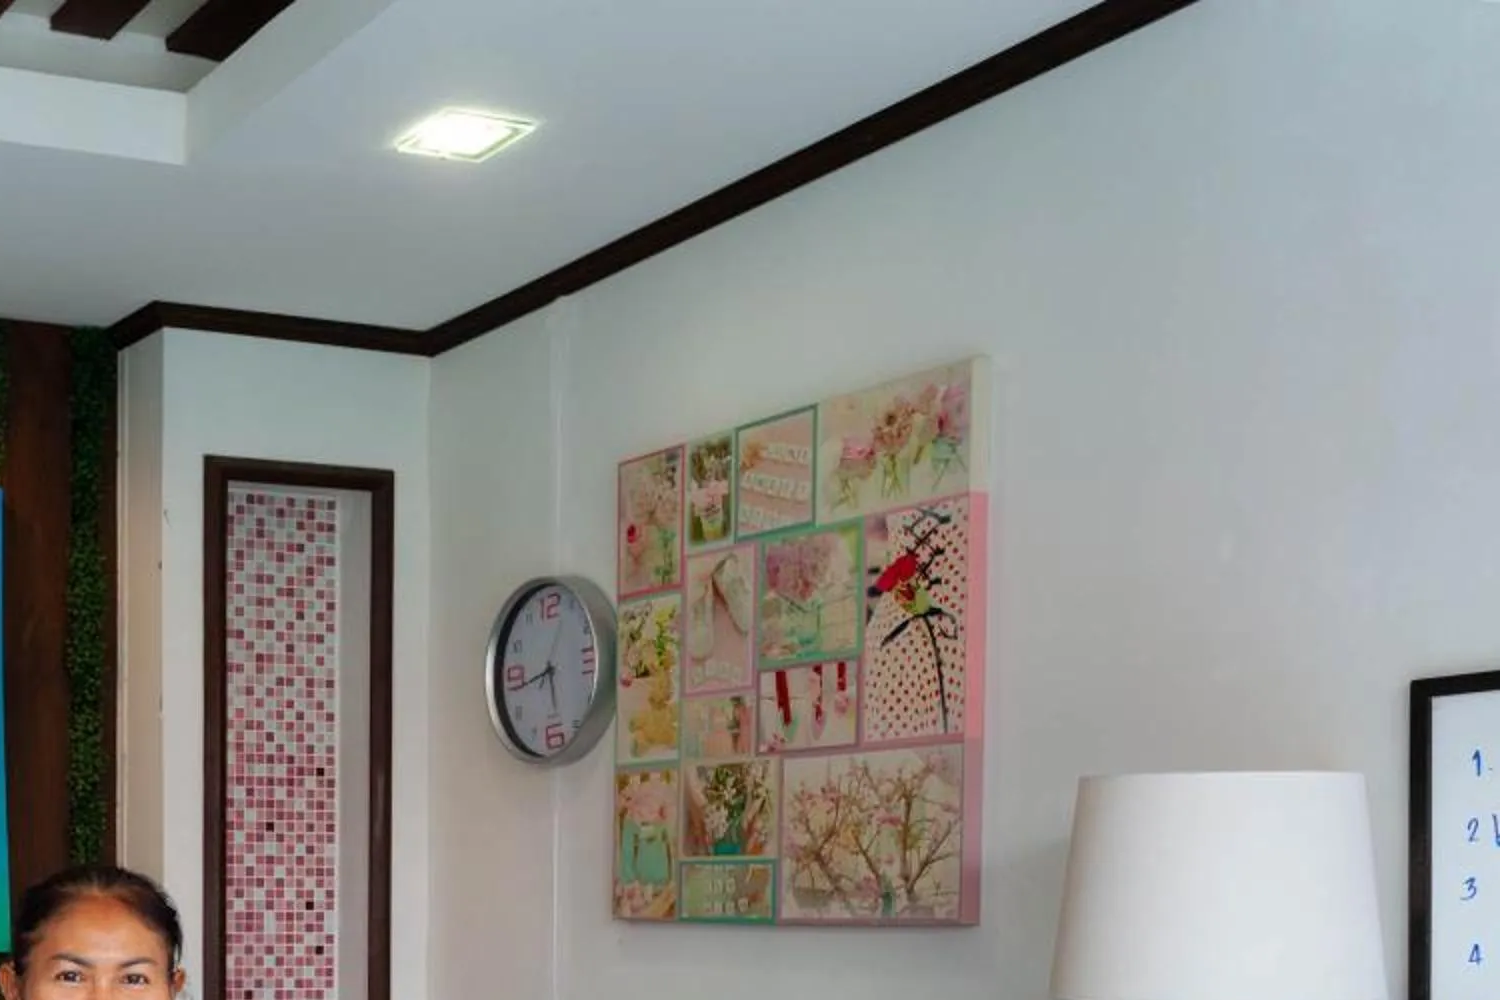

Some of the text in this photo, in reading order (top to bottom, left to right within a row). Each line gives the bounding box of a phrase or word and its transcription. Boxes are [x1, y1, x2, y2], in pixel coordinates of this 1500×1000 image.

[540, 592, 561, 621] 12
[545, 721, 565, 750] 6
[1467, 817, 1480, 842] 2
[1460, 876, 1477, 900] 3
[1468, 943, 1483, 965] 4
